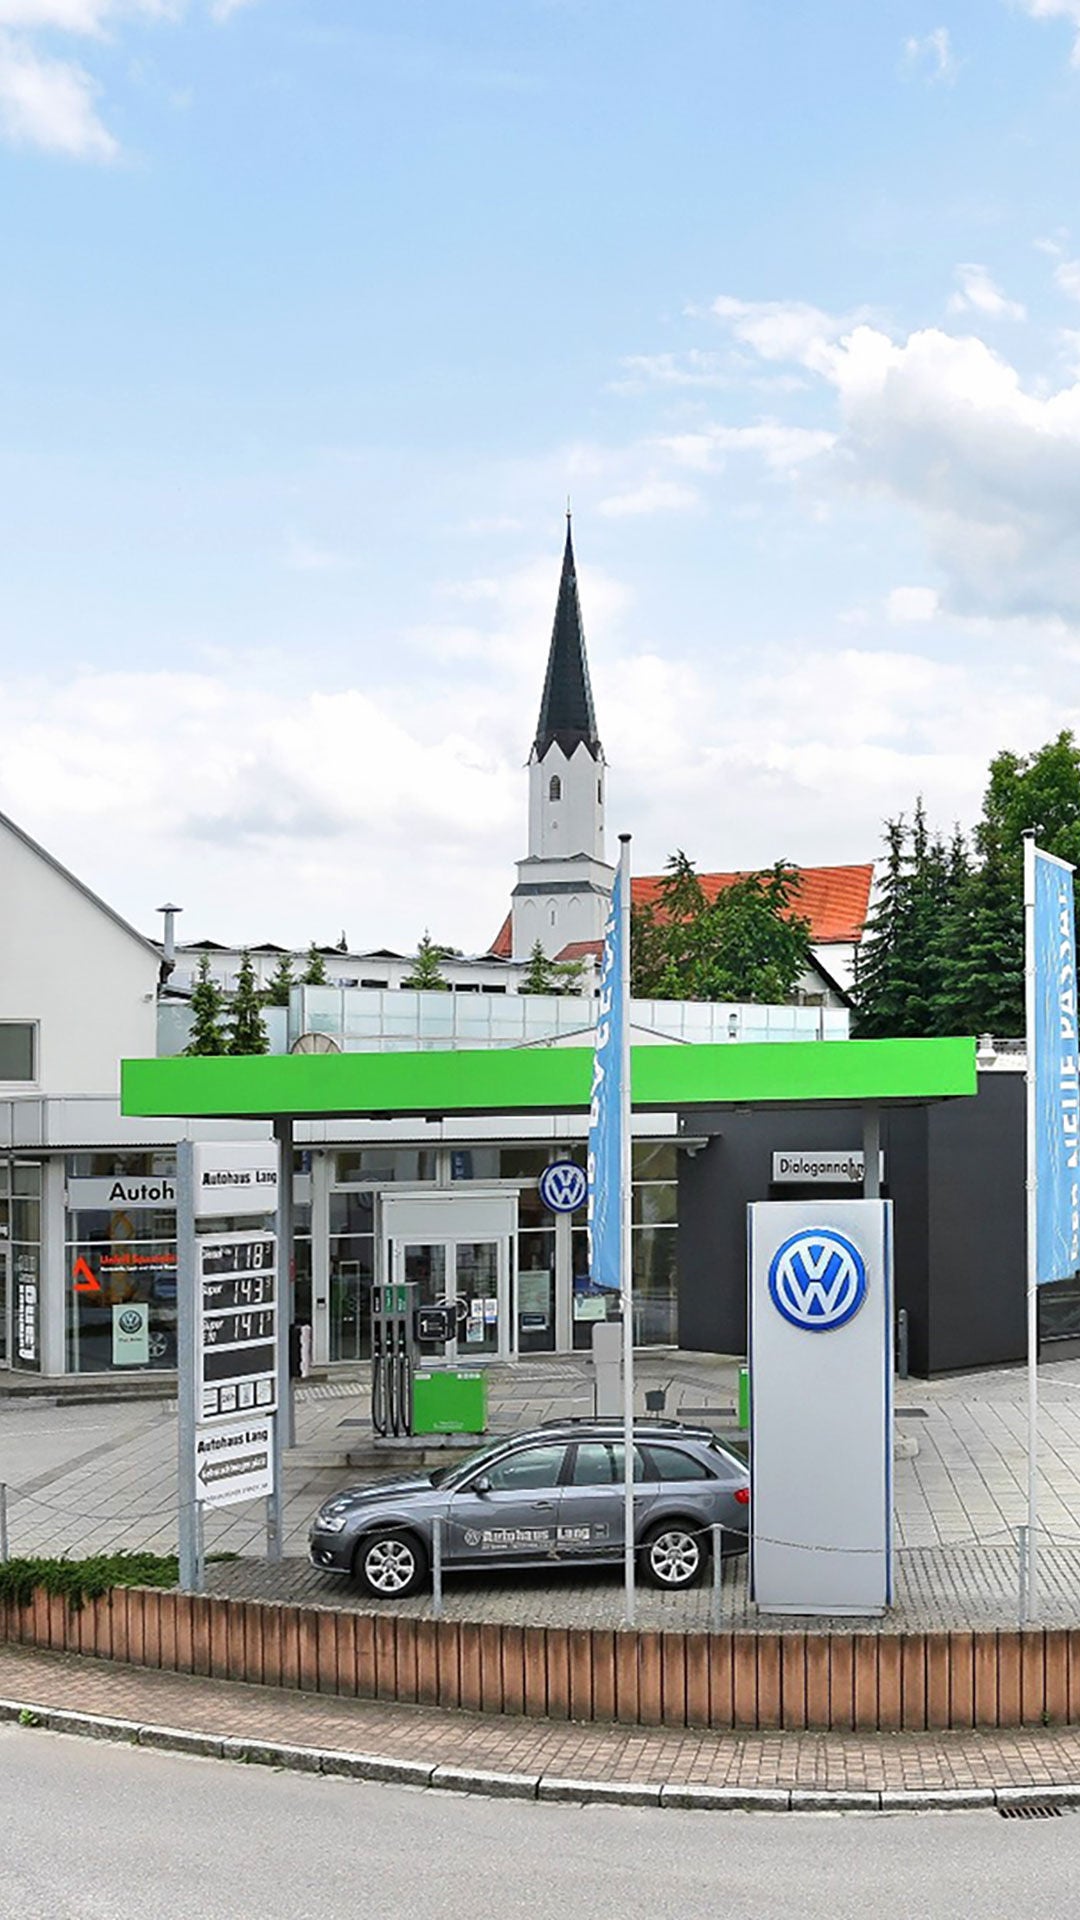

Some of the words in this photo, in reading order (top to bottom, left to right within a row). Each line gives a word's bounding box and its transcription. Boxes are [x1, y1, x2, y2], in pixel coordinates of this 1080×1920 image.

[202, 1171, 251, 1186] Autohaus
[255, 1169, 277, 1185] Lang
[776, 1236, 858, 1323] VW
[197, 1434, 244, 1453] Autohaus
[245, 1430, 268, 1443] Lang
[482, 1529, 549, 1543] Autohaus
[557, 1526, 590, 1540] Lang
